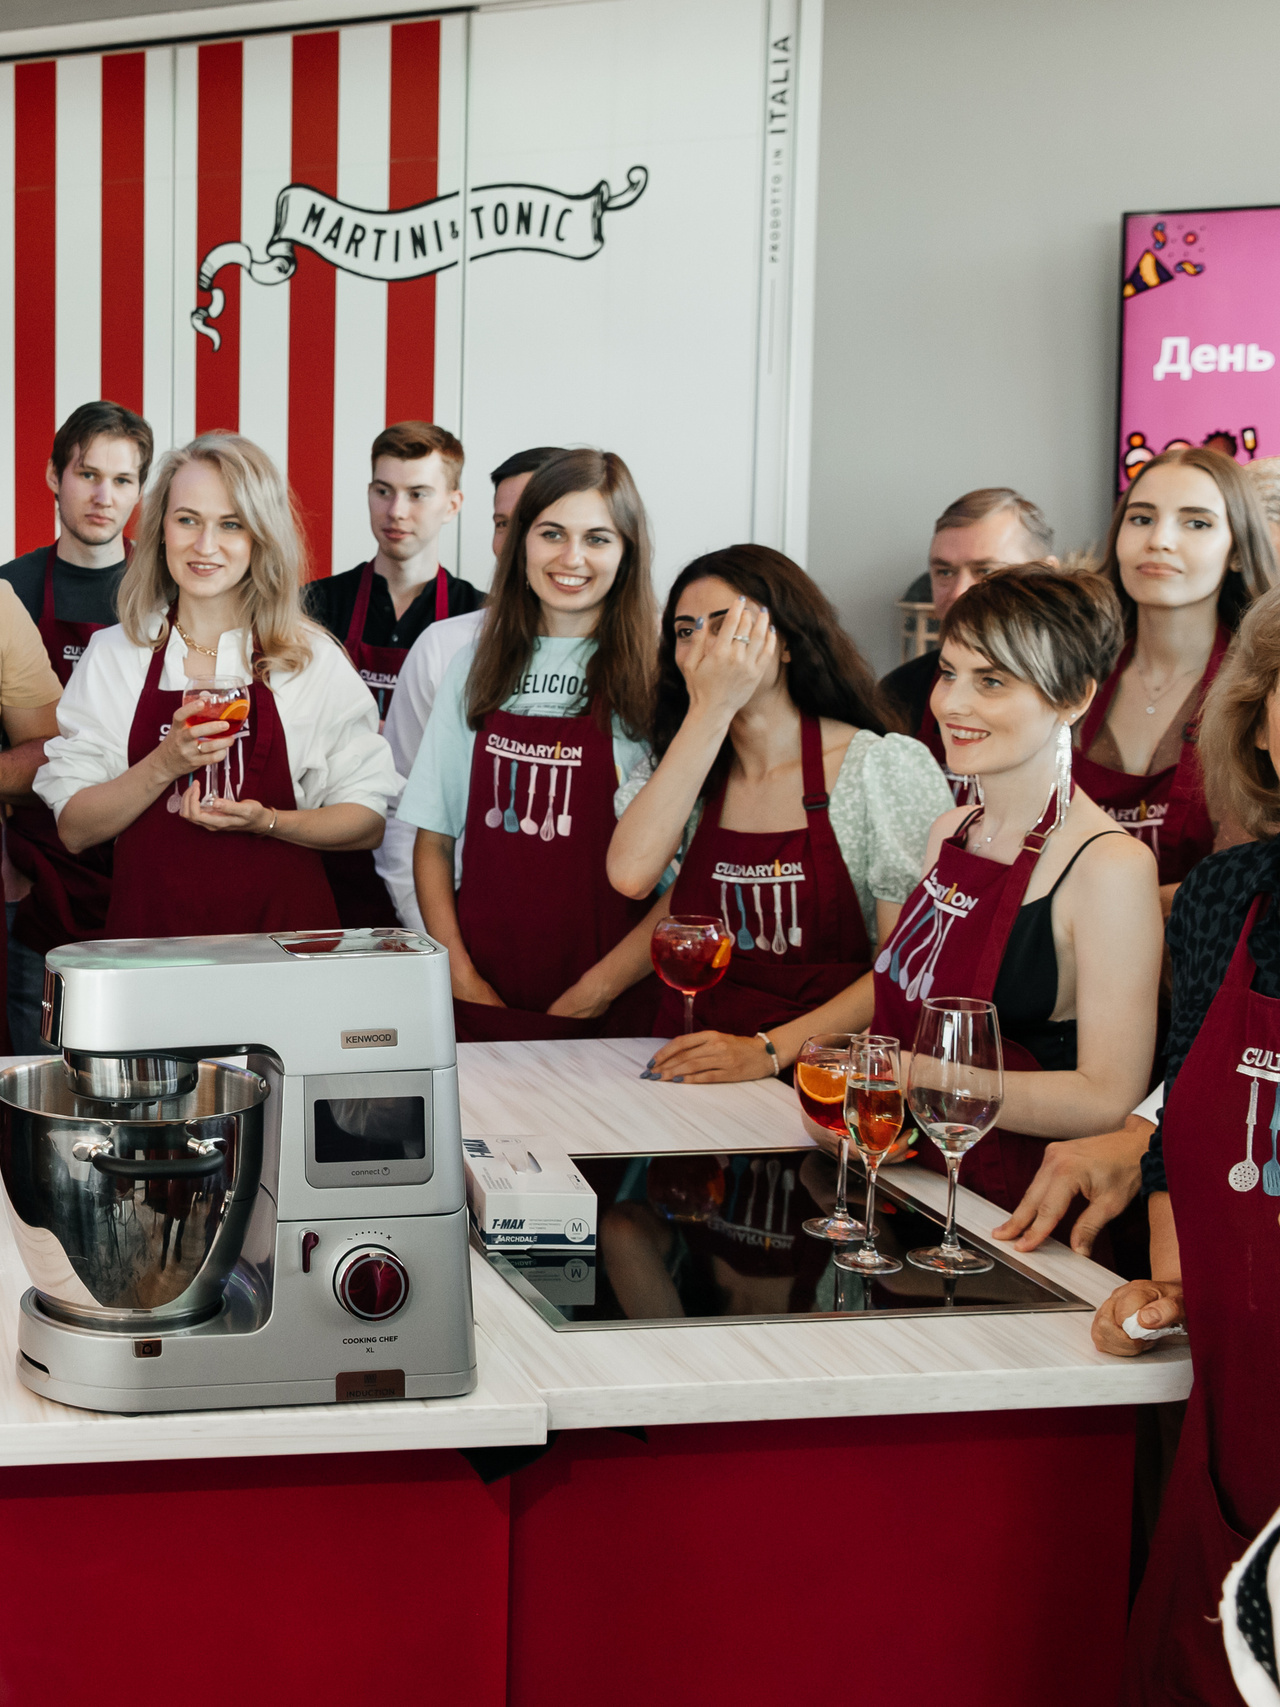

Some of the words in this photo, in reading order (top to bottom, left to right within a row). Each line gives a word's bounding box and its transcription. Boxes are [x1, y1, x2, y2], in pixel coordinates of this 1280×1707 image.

[769, 35, 791, 134] ITALIA
[302, 203, 443, 262] MARTINI
[471, 202, 572, 243] TONIC
[1152, 336, 1276, 381] День
[346, 1034, 391, 1044] KENWOOD
[351, 1168, 380, 1176] connect
[492, 1218, 526, 1230] T-MAX
[571, 1222, 583, 1233] M
[342, 1337, 377, 1345] COOKING
[379, 1335, 398, 1343] CHEF
[346, 1388, 396, 1398] INDUCTION
